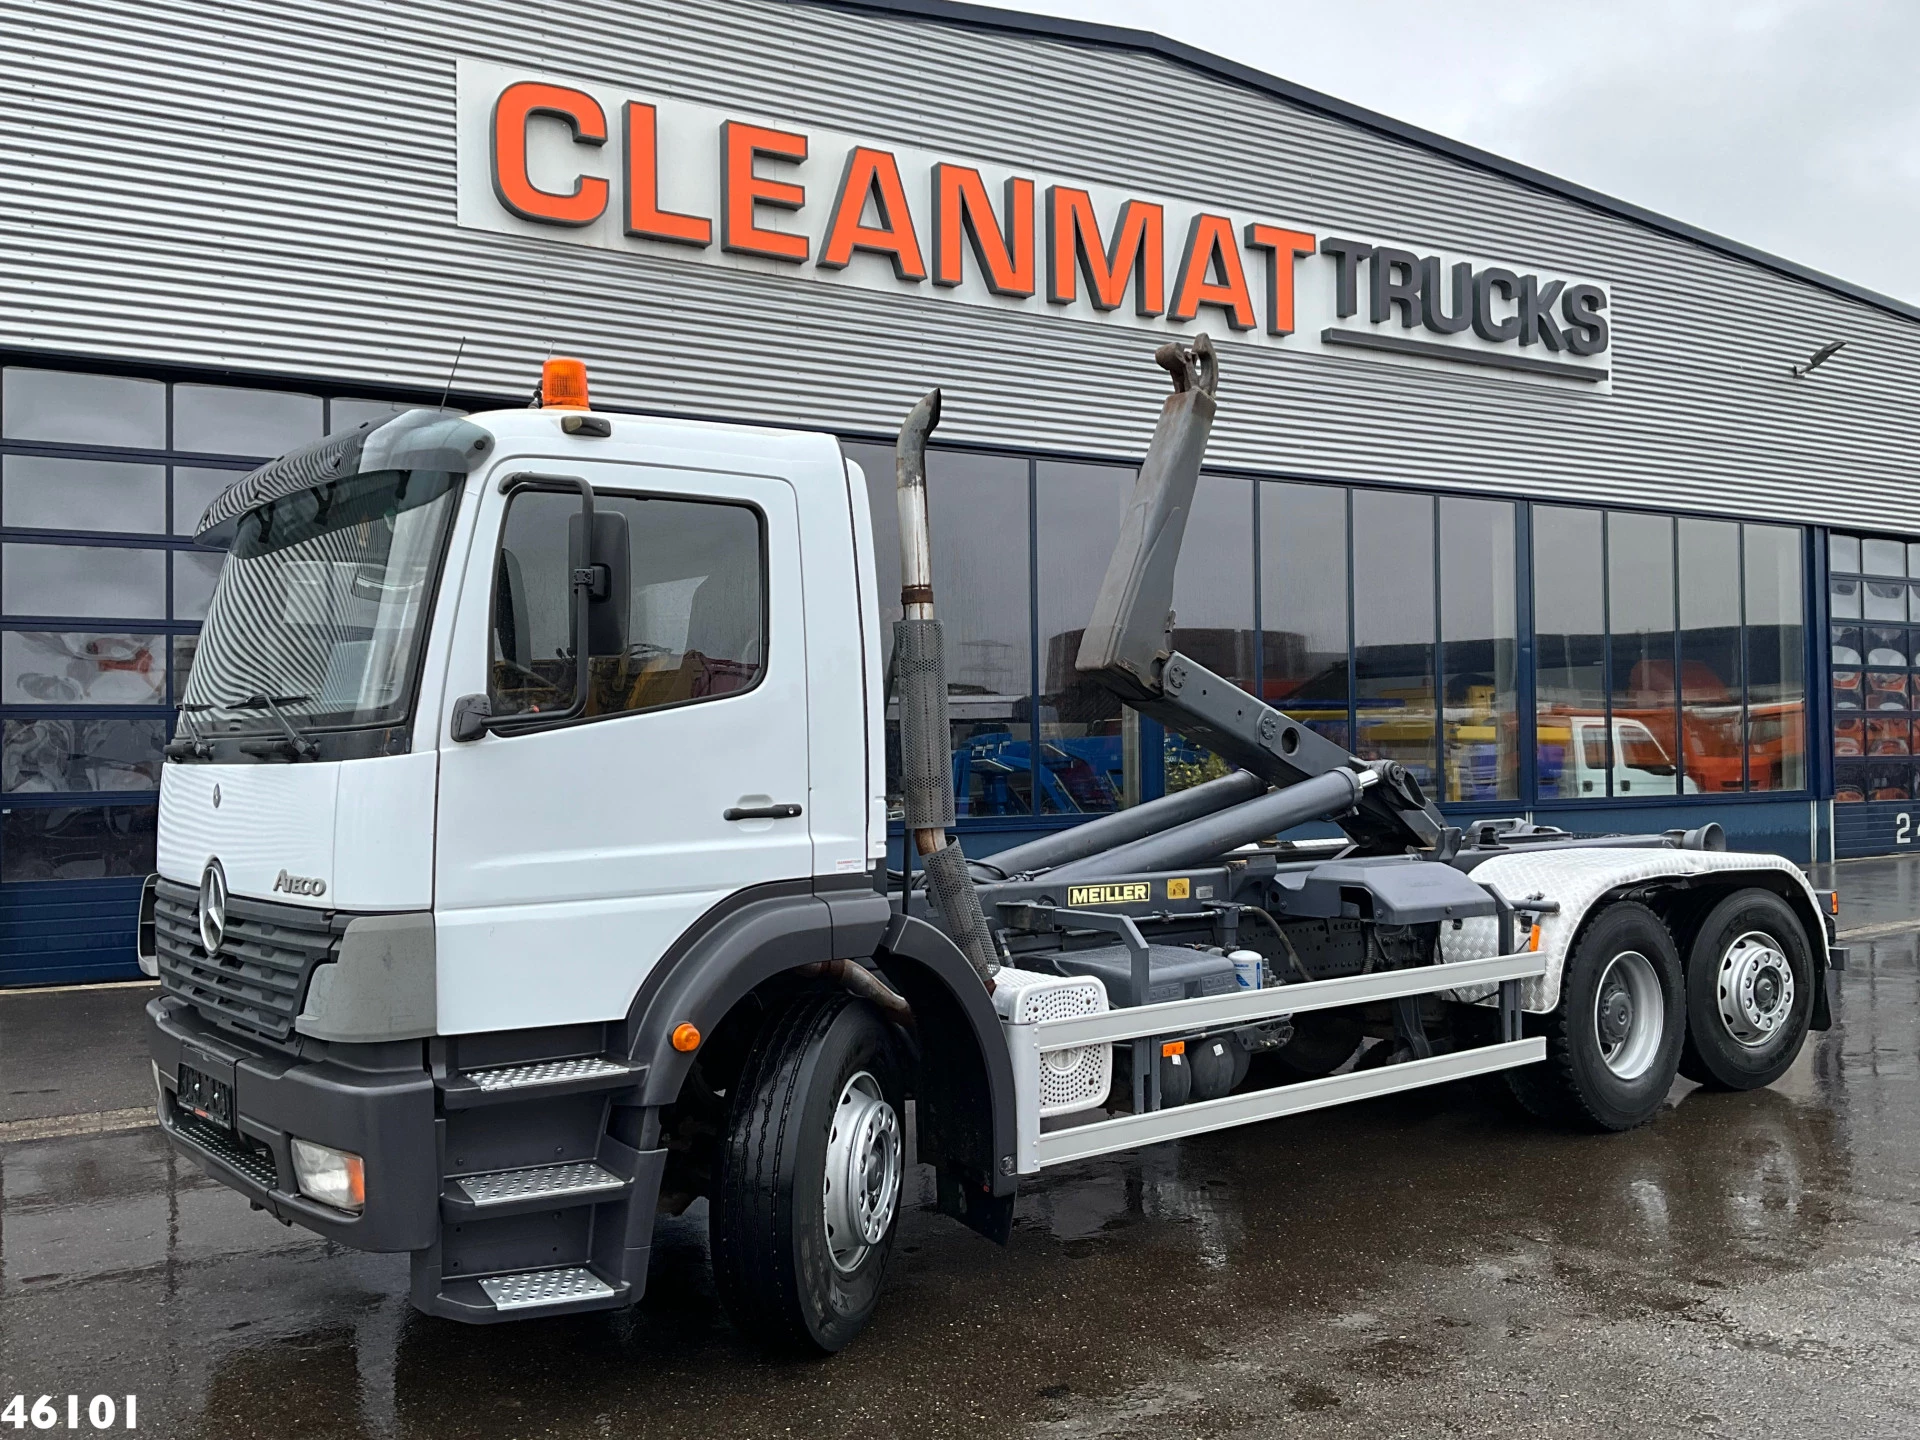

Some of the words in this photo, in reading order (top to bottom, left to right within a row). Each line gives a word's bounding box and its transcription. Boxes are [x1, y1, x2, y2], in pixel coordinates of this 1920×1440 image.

[490, 81, 1316, 338] CLEANMAT
[1320, 236, 1610, 357] TRUCKS
[1896, 812, 1920, 844] 2
[1071, 884, 1147, 905] MEILLER
